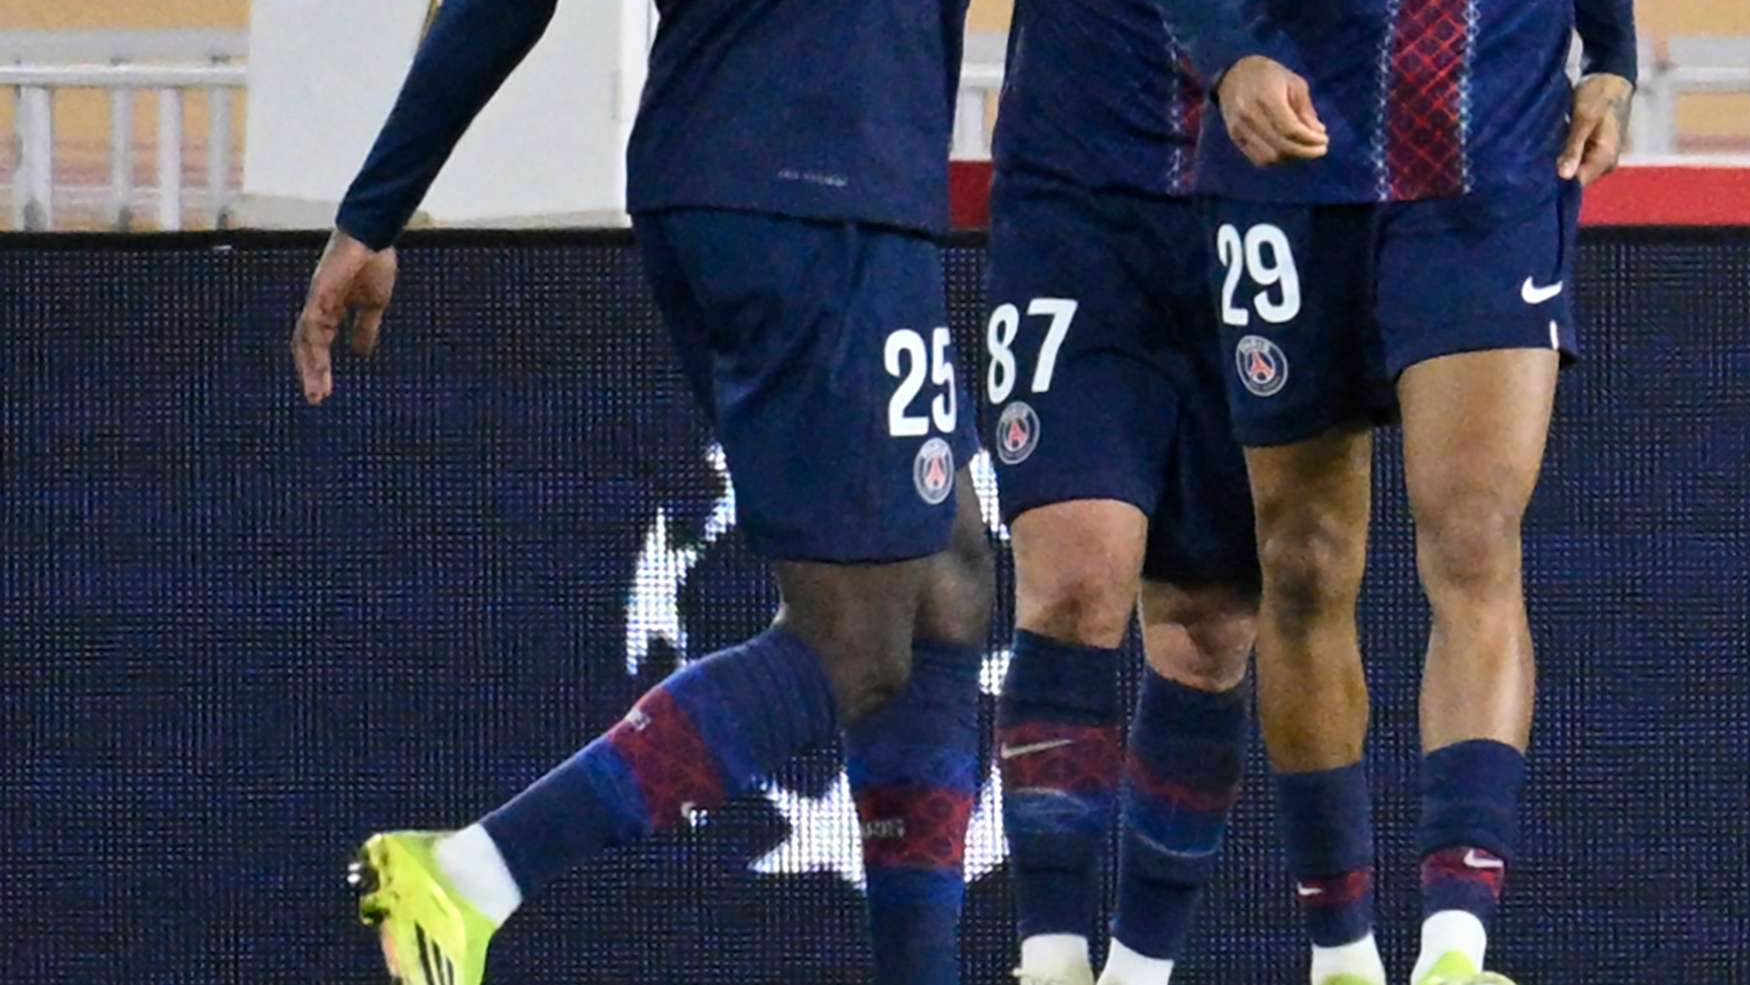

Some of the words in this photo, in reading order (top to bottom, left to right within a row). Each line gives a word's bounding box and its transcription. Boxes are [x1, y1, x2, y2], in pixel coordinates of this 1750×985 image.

[1217, 223, 1301, 326] 29
[884, 327, 957, 437] 25
[987, 298, 1078, 404] 87
